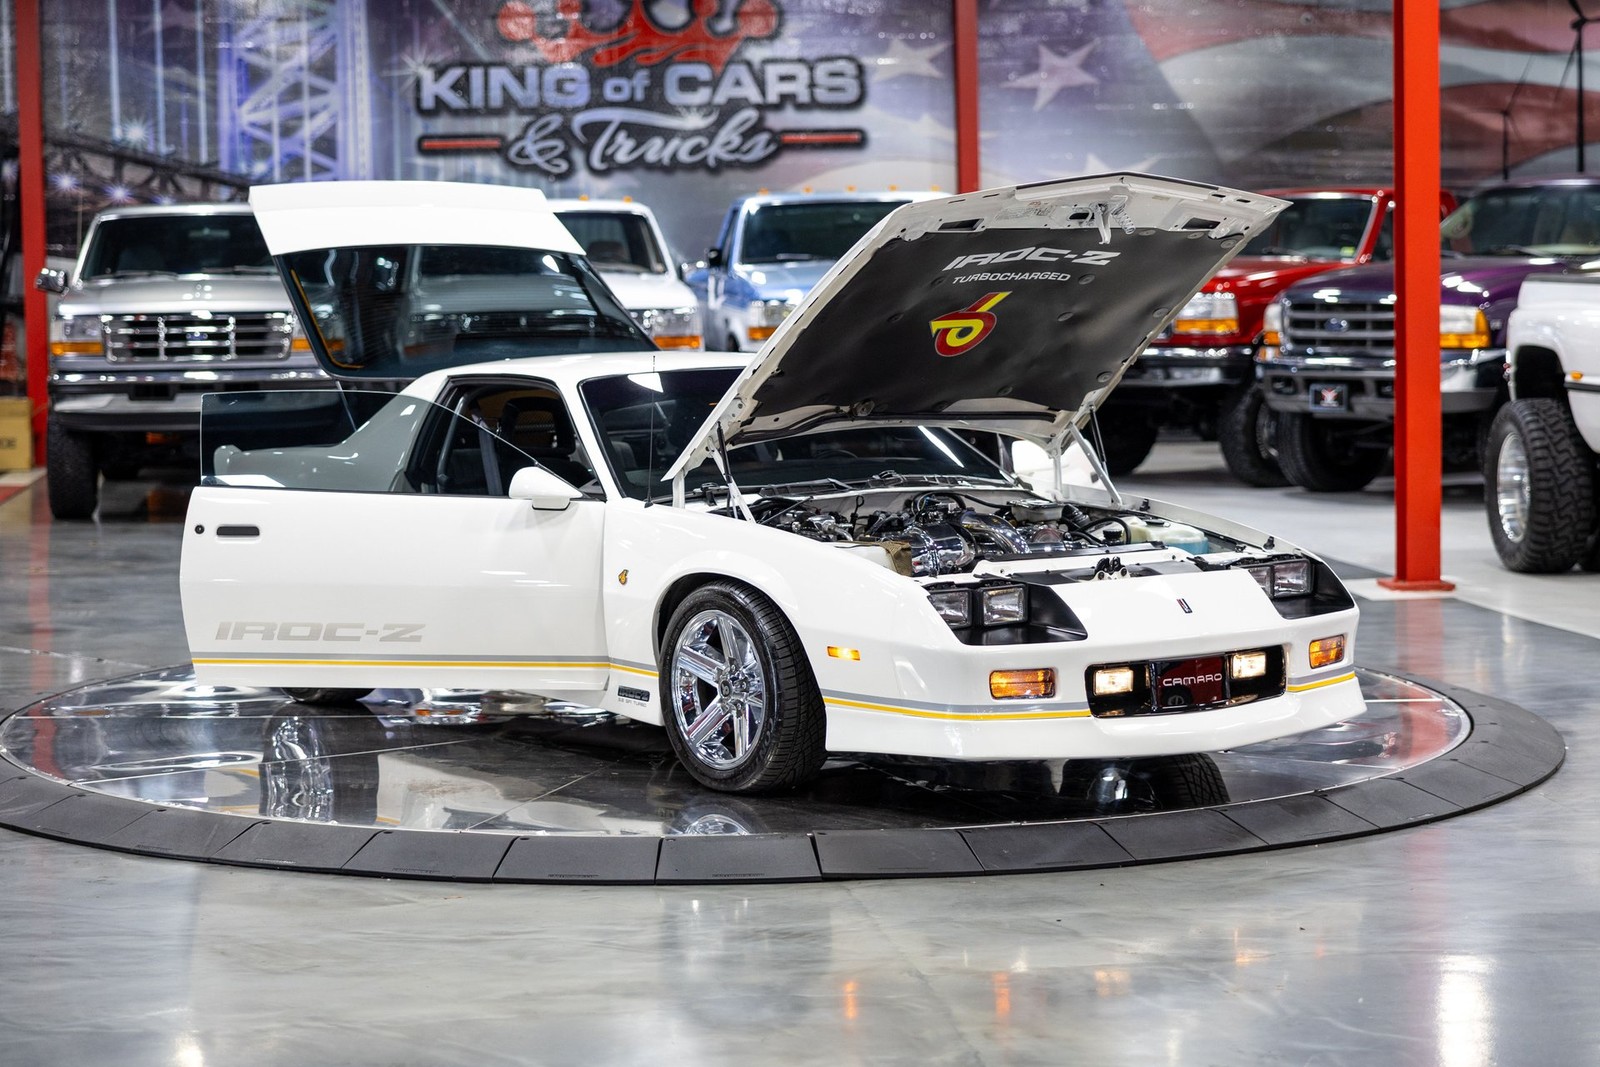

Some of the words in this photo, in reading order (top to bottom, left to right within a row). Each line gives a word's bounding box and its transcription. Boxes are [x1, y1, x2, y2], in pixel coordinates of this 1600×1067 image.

[420, 63, 591, 110] KING
[603, 69, 651, 102] of
[663, 60, 863, 106] CARS
[508, 113, 569, 174] &
[572, 106, 780, 170] Trucks
[942, 246, 1121, 271] IROC-Z
[952, 271, 1072, 285] TURBOCHARGED
[214, 621, 426, 643] IROC-Z
[1162, 672, 1223, 687] CAMARO
